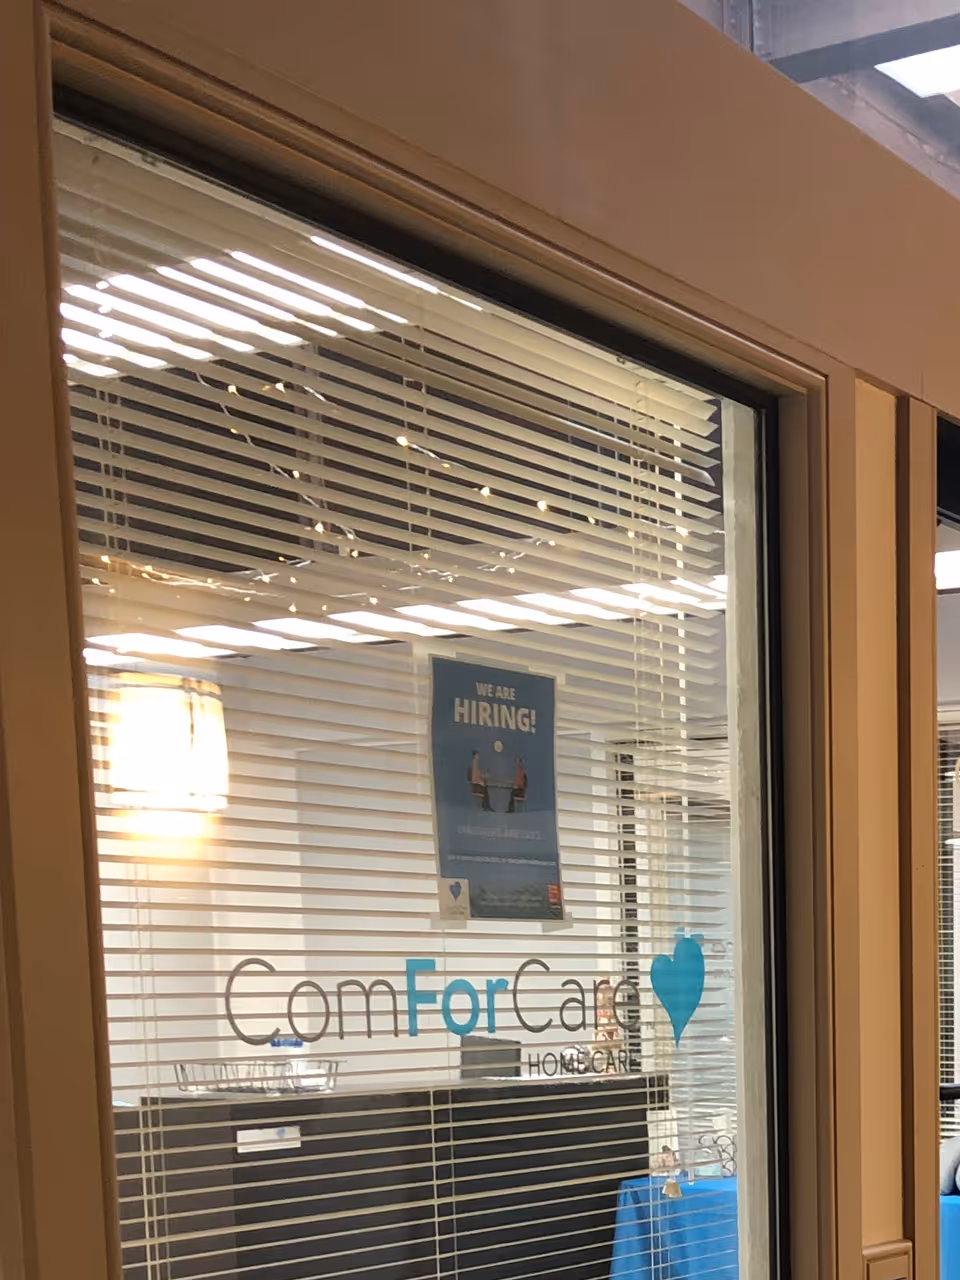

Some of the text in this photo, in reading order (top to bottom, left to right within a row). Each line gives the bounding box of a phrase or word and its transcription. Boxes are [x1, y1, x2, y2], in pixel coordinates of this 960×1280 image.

[476, 682, 516, 700] WE ARE
[454, 697, 537, 735] HIRING!
[225, 957, 642, 1046] ComForCare
[527, 1049, 639, 1077] HOME CARE
